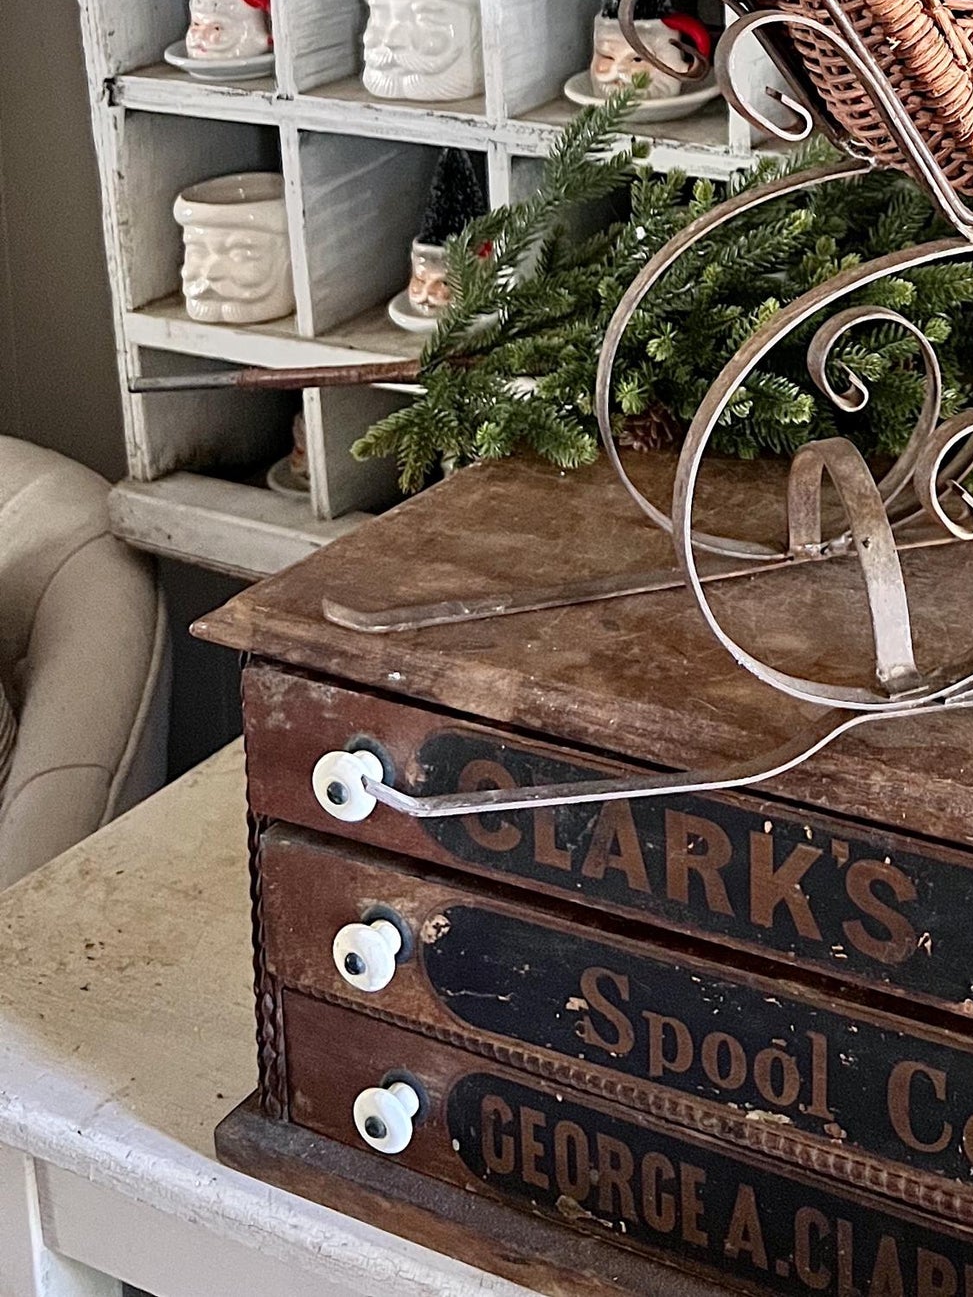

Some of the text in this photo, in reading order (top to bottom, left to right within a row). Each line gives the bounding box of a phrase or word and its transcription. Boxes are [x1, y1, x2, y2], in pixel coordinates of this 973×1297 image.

[458, 759, 919, 966] CLARK'S
[577, 966, 835, 1121] Spool
[481, 1094, 709, 1248] GEORGE
